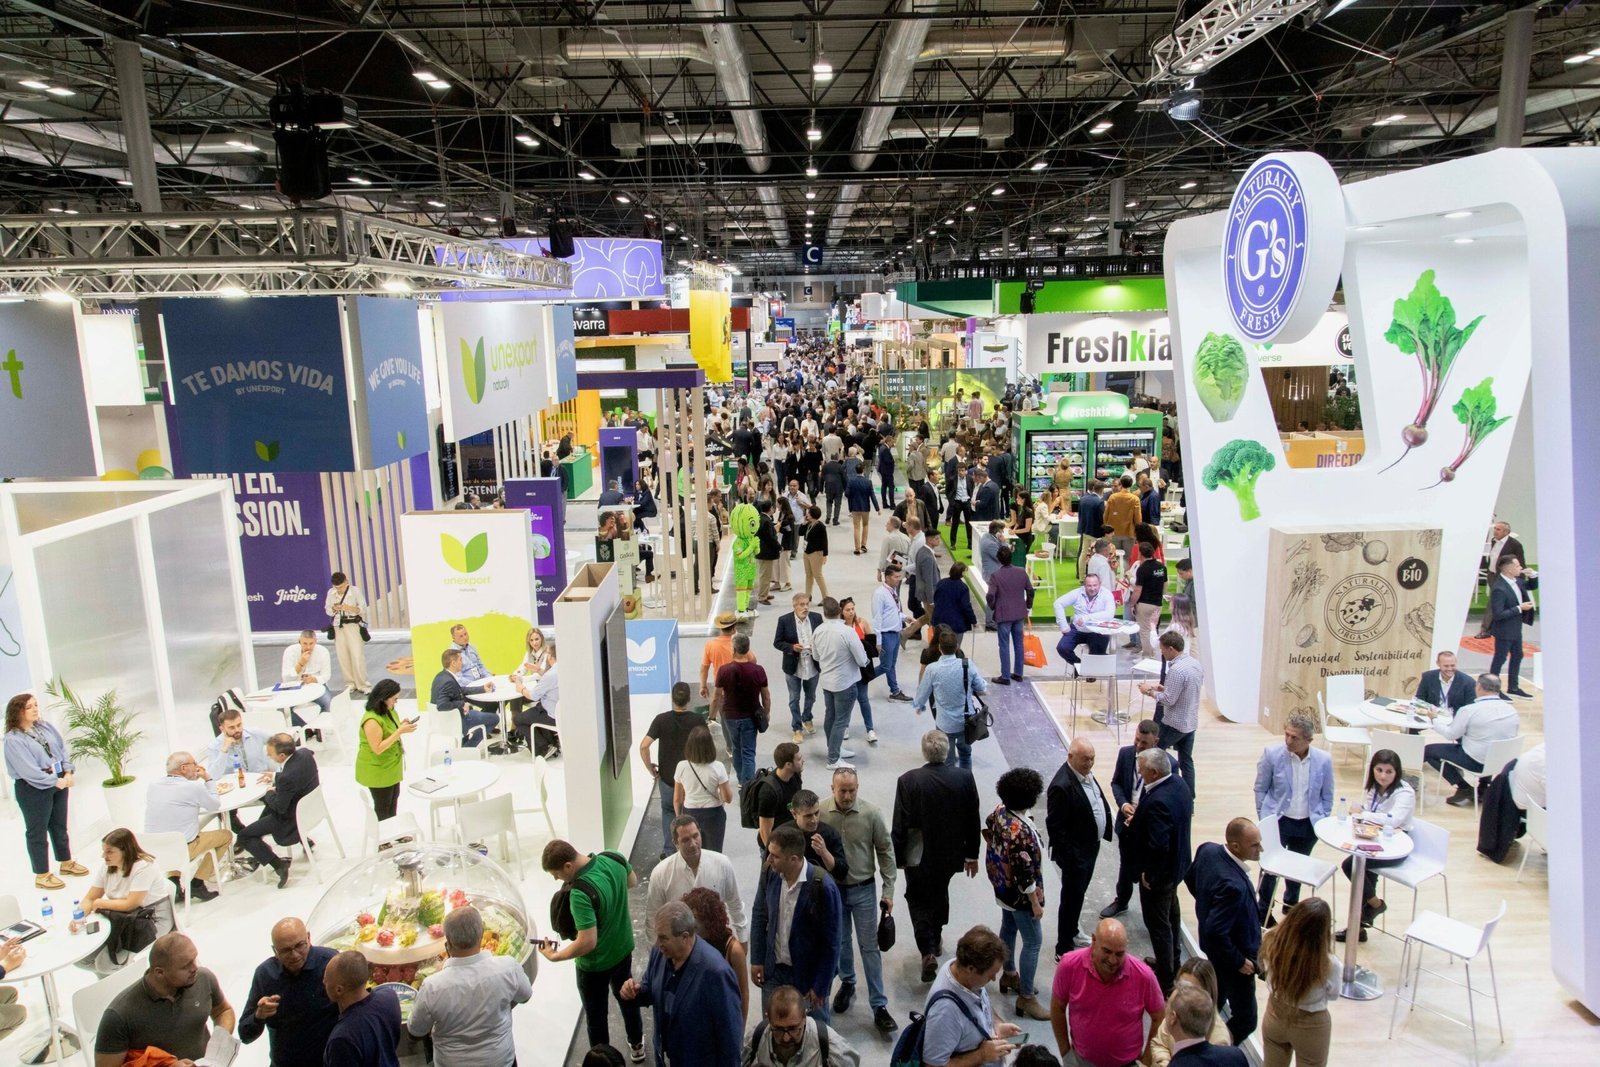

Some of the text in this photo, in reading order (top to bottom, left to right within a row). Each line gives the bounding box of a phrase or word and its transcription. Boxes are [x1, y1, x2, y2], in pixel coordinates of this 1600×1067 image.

[1235, 170, 1301, 224] NATURALLY
[806, 246, 820, 263] C
[1240, 218, 1286, 281] G's
[1240, 303, 1282, 331] FRESH
[490, 334, 537, 377] unexport
[1047, 328, 1173, 364] Freshkia
[181, 360, 334, 396] TE DAMOS VIDA
[368, 367, 381, 392] WE
[379, 358, 395, 380] GIVE
[394, 357, 408, 376] YOU
[407, 361, 421, 385] LIFE
[235, 384, 287, 396] BY UNEXPORT
[1335, 577, 1390, 597] NATURALLY
[1402, 568, 1423, 582] BIO
[274, 585, 317, 605] Jimbee
[1337, 628, 1380, 641] ORGANIC
[1288, 649, 1424, 666] Integridad Sostenibilidad
